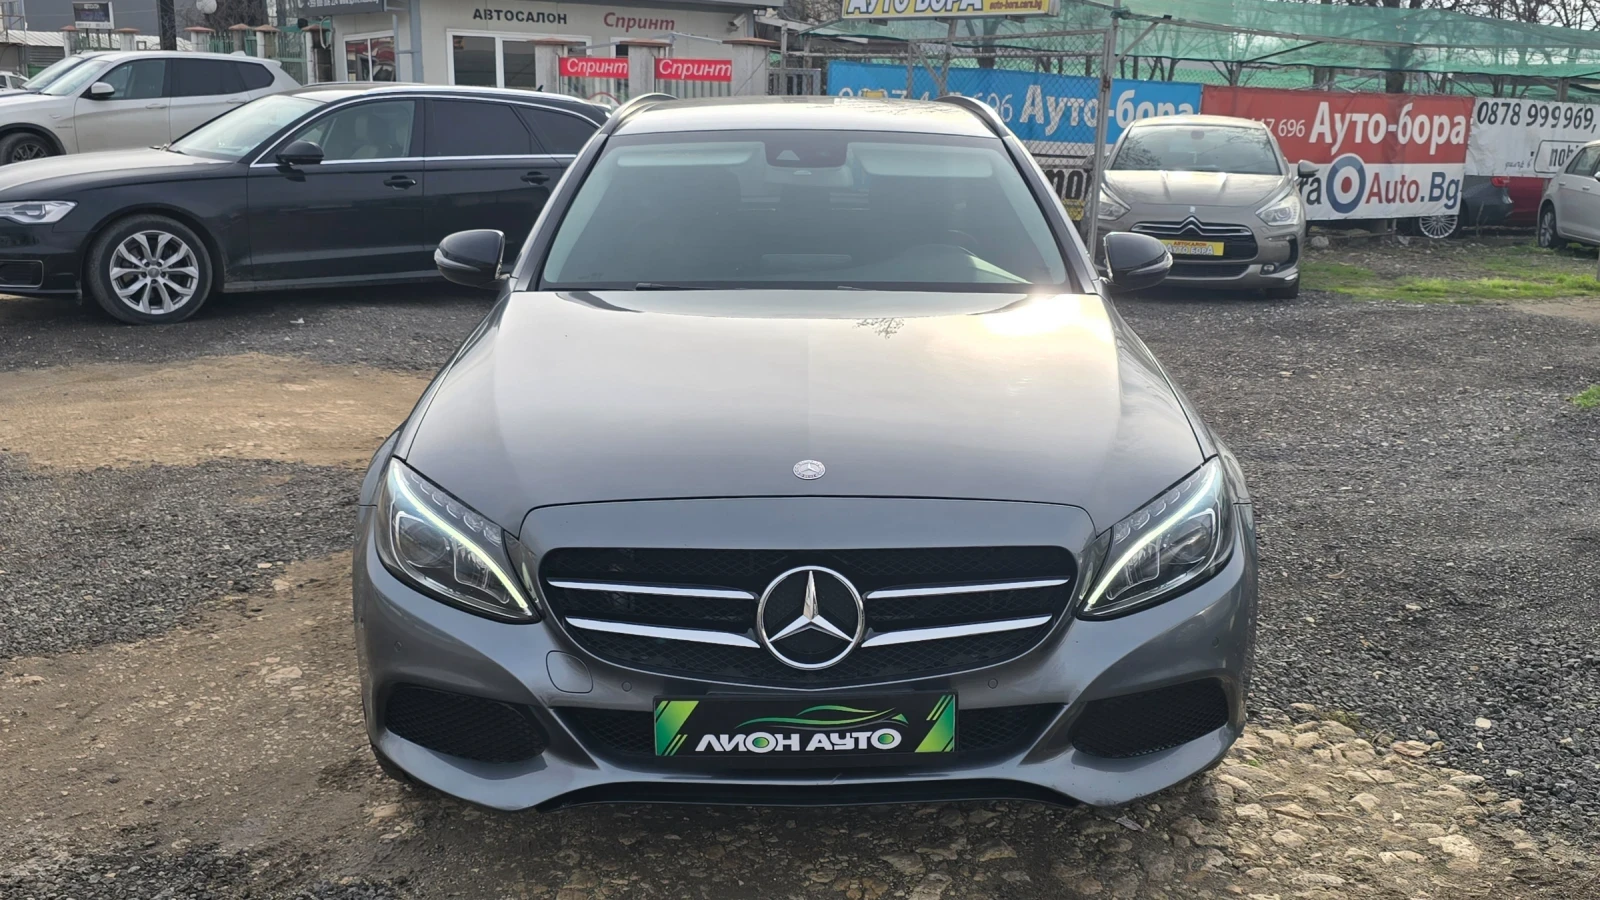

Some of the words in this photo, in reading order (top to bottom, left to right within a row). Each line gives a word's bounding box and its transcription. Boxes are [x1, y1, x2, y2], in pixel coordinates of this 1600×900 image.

[473, 8, 568, 25] АВТОСАЛОН
[604, 12, 675, 33] Спринт
[566, 58, 629, 77] Спринт
[659, 60, 732, 81] Спринт
[1477, 101, 1522, 126] 0878
[1278, 119, 1305, 137] 696
[1309, 101, 1466, 156] Ауто-бора
[1365, 171, 1460, 210] Auto.Bg
[695, 731, 800, 754] ЛИОН
[804, 728, 903, 752] АУТО
